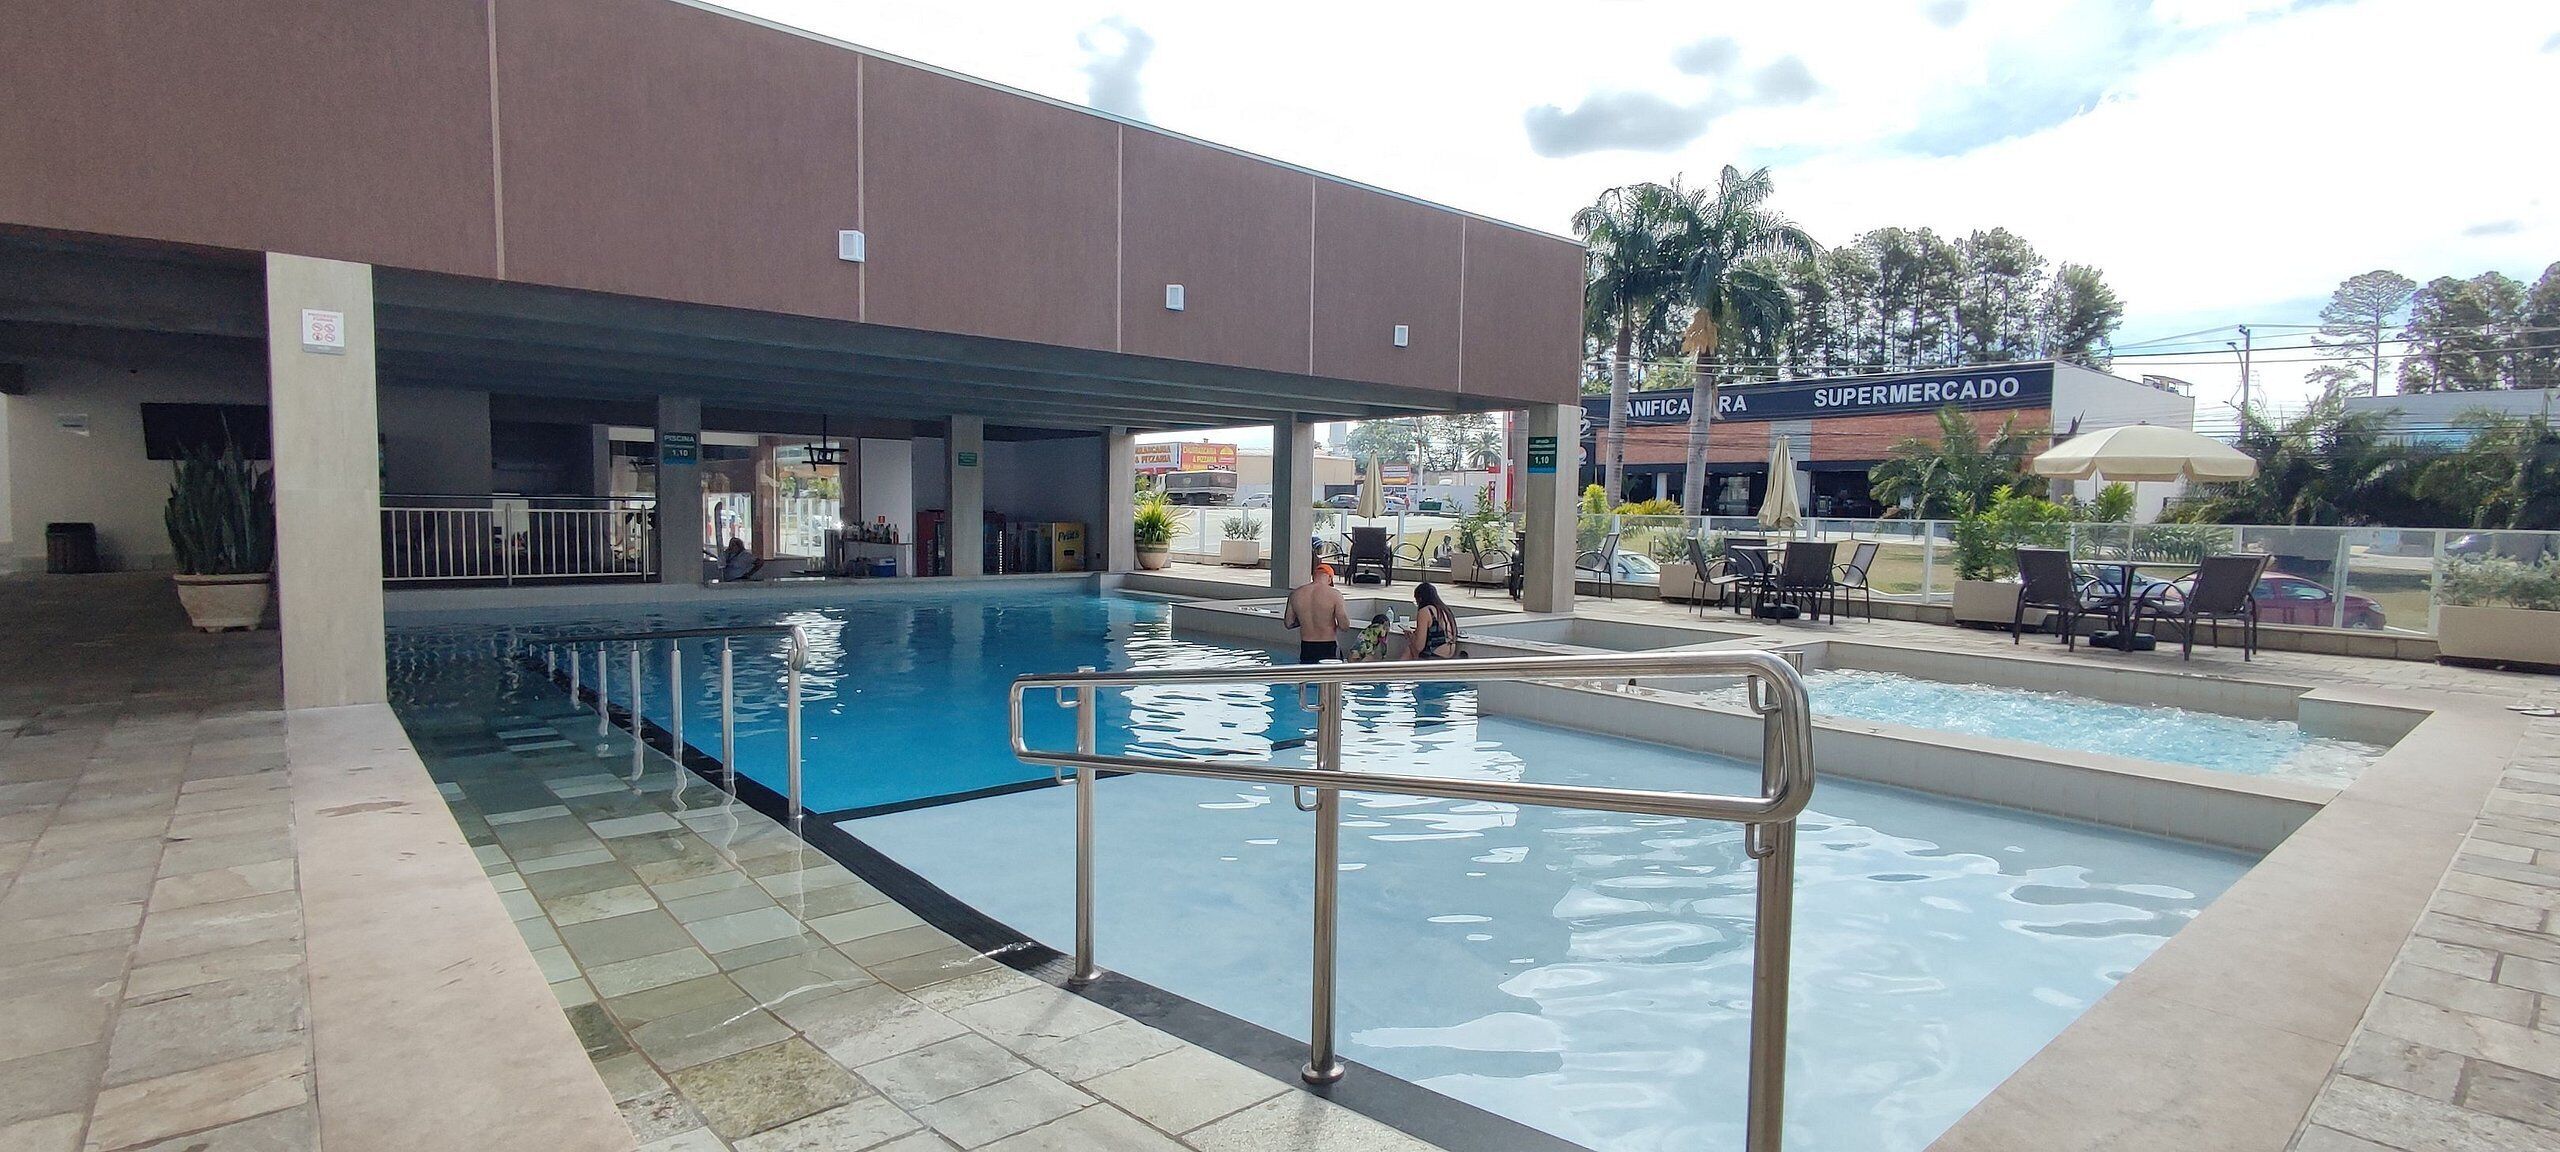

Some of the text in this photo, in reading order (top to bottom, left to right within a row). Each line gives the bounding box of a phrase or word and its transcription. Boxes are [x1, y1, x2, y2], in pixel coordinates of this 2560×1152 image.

[1625, 377, 2020, 418] ANIFICARA SUPERMERCADO
[1535, 456, 1549, 464] 1,10
